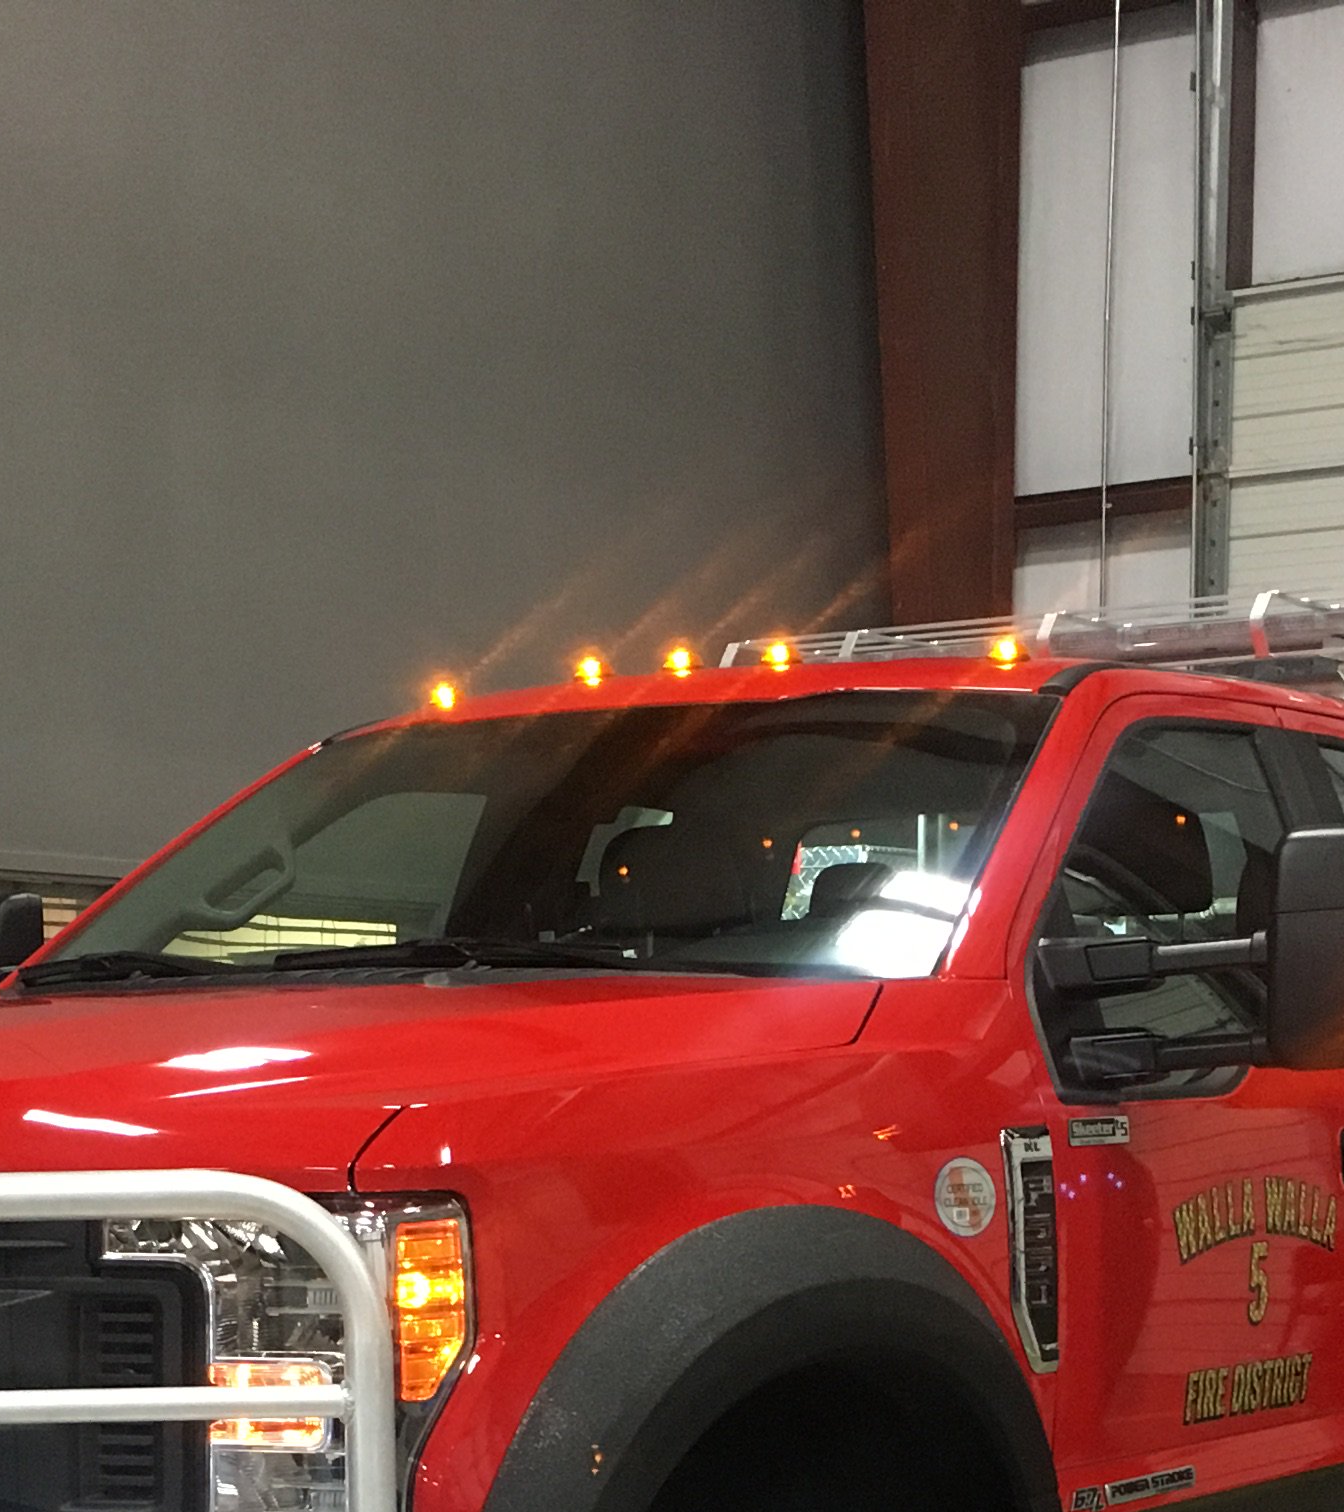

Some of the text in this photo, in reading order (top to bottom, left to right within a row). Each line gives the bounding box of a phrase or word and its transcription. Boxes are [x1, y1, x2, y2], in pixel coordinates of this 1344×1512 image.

[1173, 1176, 1337, 1264] WALLA WALLA
[1249, 1241, 1269, 1325] 5
[1183, 1352, 1313, 1426] FIRE DISTRICT
[1151, 1468, 1193, 1488] STROKE
